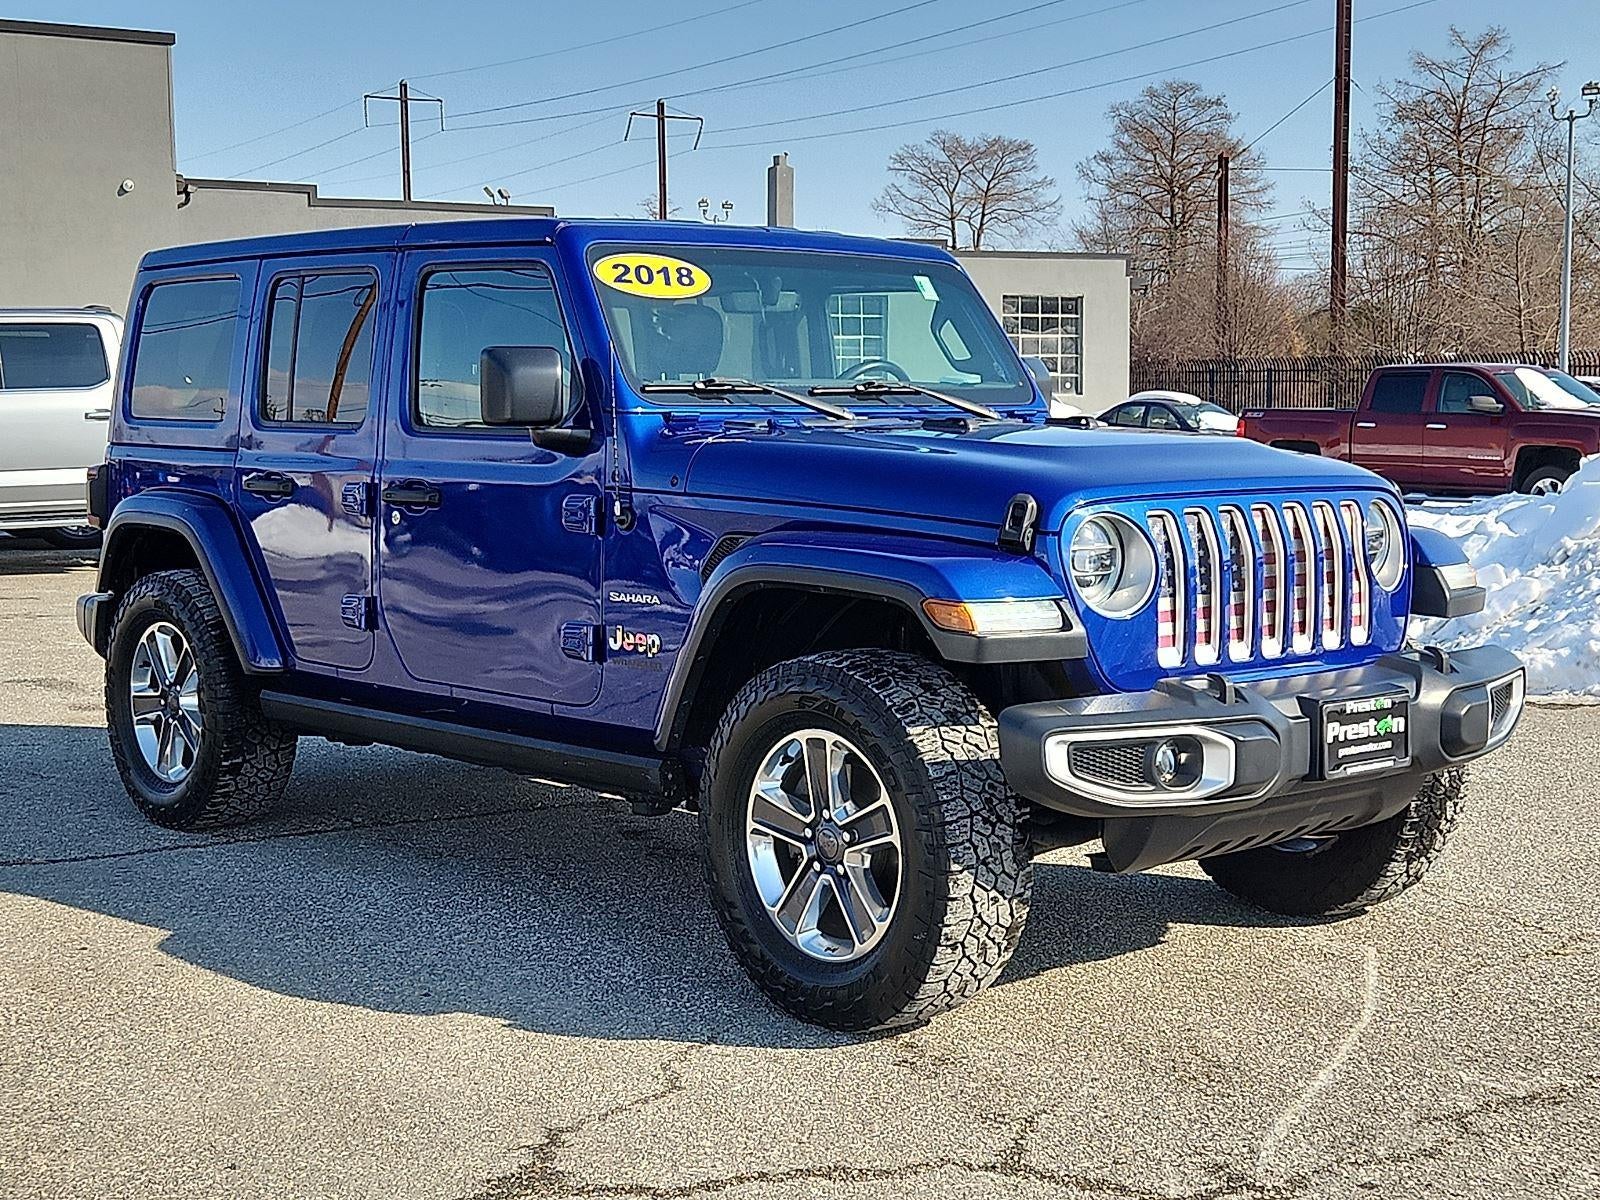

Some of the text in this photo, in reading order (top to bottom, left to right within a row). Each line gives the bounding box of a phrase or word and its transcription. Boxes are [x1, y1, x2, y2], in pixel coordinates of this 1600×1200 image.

[611, 263, 695, 287] 2018
[609, 591, 661, 605] SAHARA
[608, 625, 661, 658] Jeep
